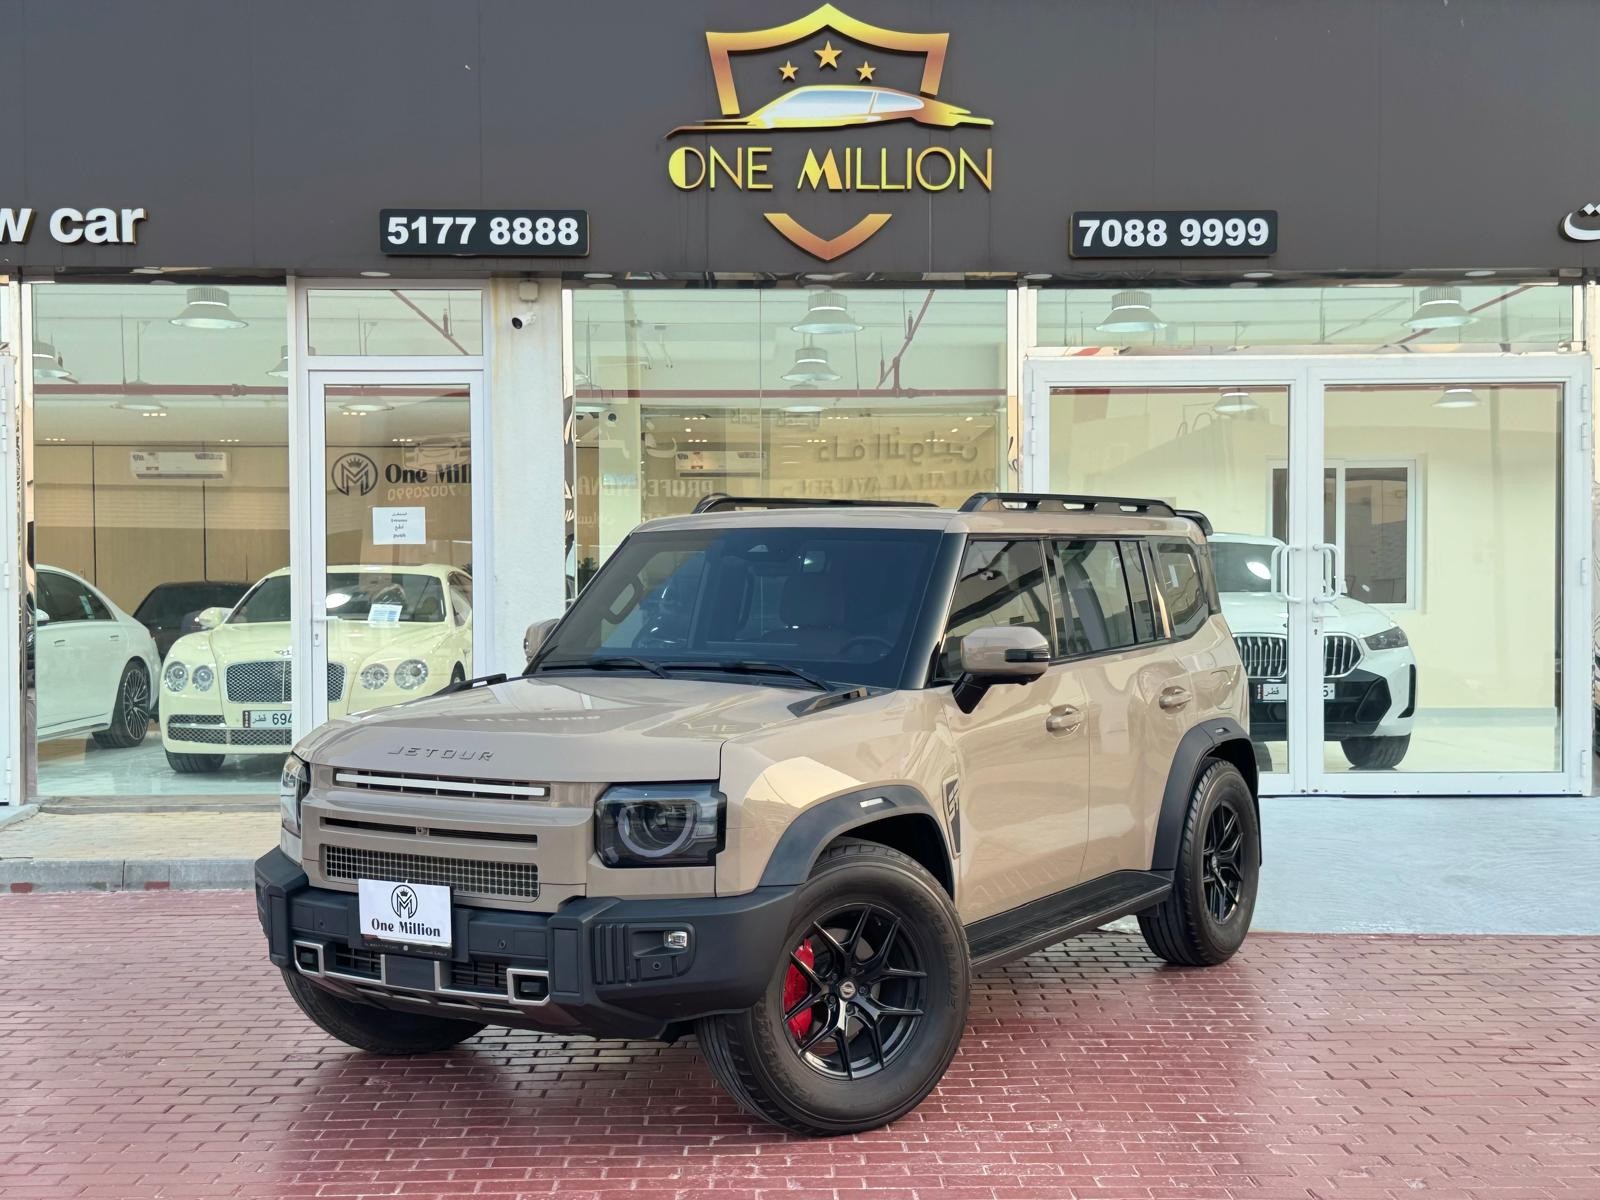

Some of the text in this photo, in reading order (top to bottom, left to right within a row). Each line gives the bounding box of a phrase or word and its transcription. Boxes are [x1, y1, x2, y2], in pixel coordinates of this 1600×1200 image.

[668, 146, 993, 191] ONE MILLION
[49, 207, 146, 244] car
[387, 216, 579, 246] 5177 8888
[1079, 218, 1269, 247] 7088 9999
[385, 463, 428, 484] One
[387, 745, 496, 762] JETOUR
[371, 918, 442, 938] One Million
